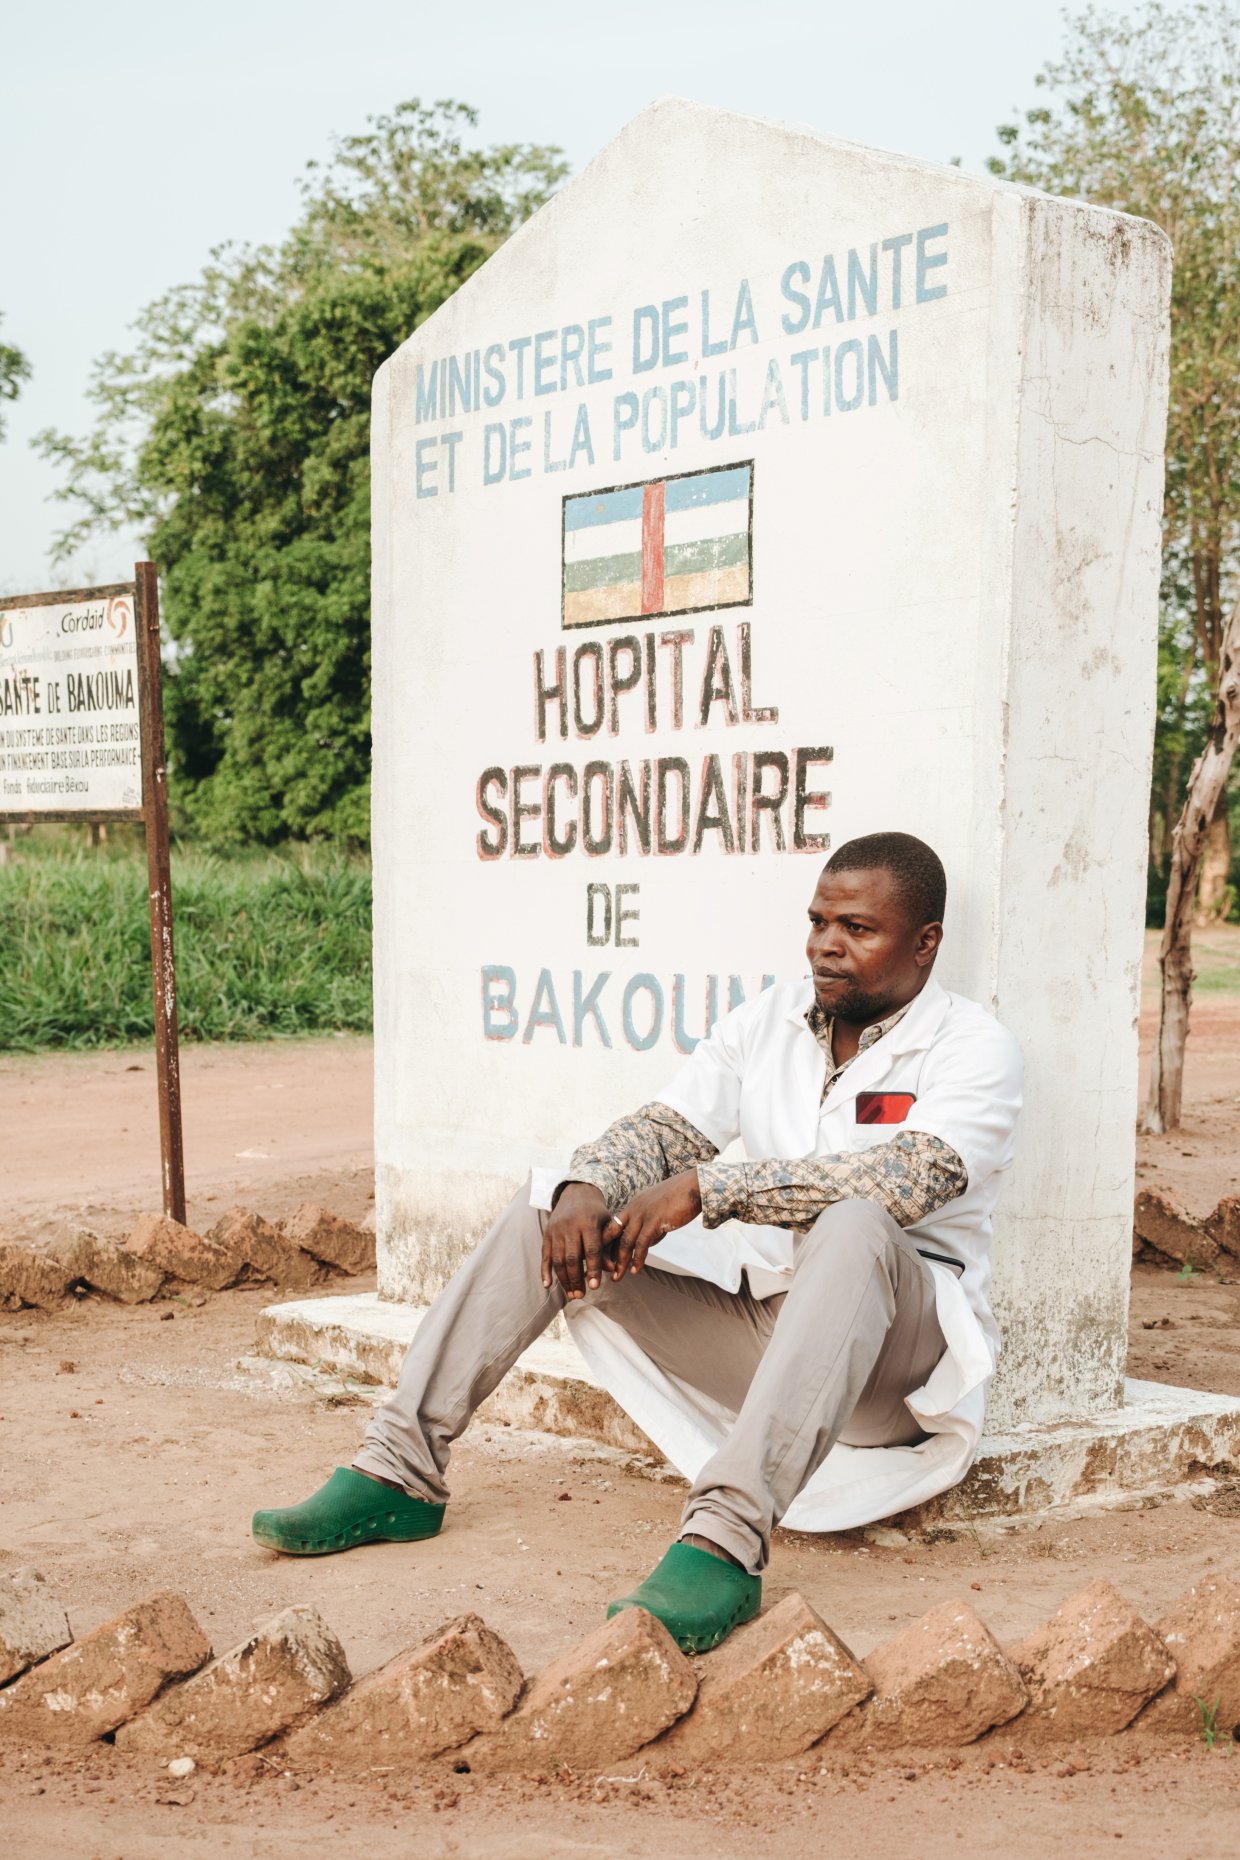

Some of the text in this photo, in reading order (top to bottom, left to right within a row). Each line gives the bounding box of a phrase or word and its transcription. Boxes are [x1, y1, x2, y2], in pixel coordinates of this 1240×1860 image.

[415, 222, 949, 424] MINISTERE DE LA SANTE
[415, 329, 899, 499] ET DE LA POPULATION
[61, 607, 105, 634] Cordaid
[48, 682, 61, 714] DE
[67, 669, 135, 713] BAKOUMA
[533, 622, 779, 744] HOPITAL
[46, 727, 54, 746] DE
[55, 726, 76, 745] SANTE
[78, 725, 94, 744] DANS
[96, 723, 108, 743] LES
[110, 722, 139, 742] REGIONS
[51, 751, 67, 769] BASE
[69, 750, 80, 768] SUR
[81, 749, 89, 768] LA
[91, 747, 136, 768] PERFORMANCE
[476, 745, 834, 861] SECONDAIRE
[586, 883, 640, 948] DE
[480, 964, 813, 1055] BAKOU
